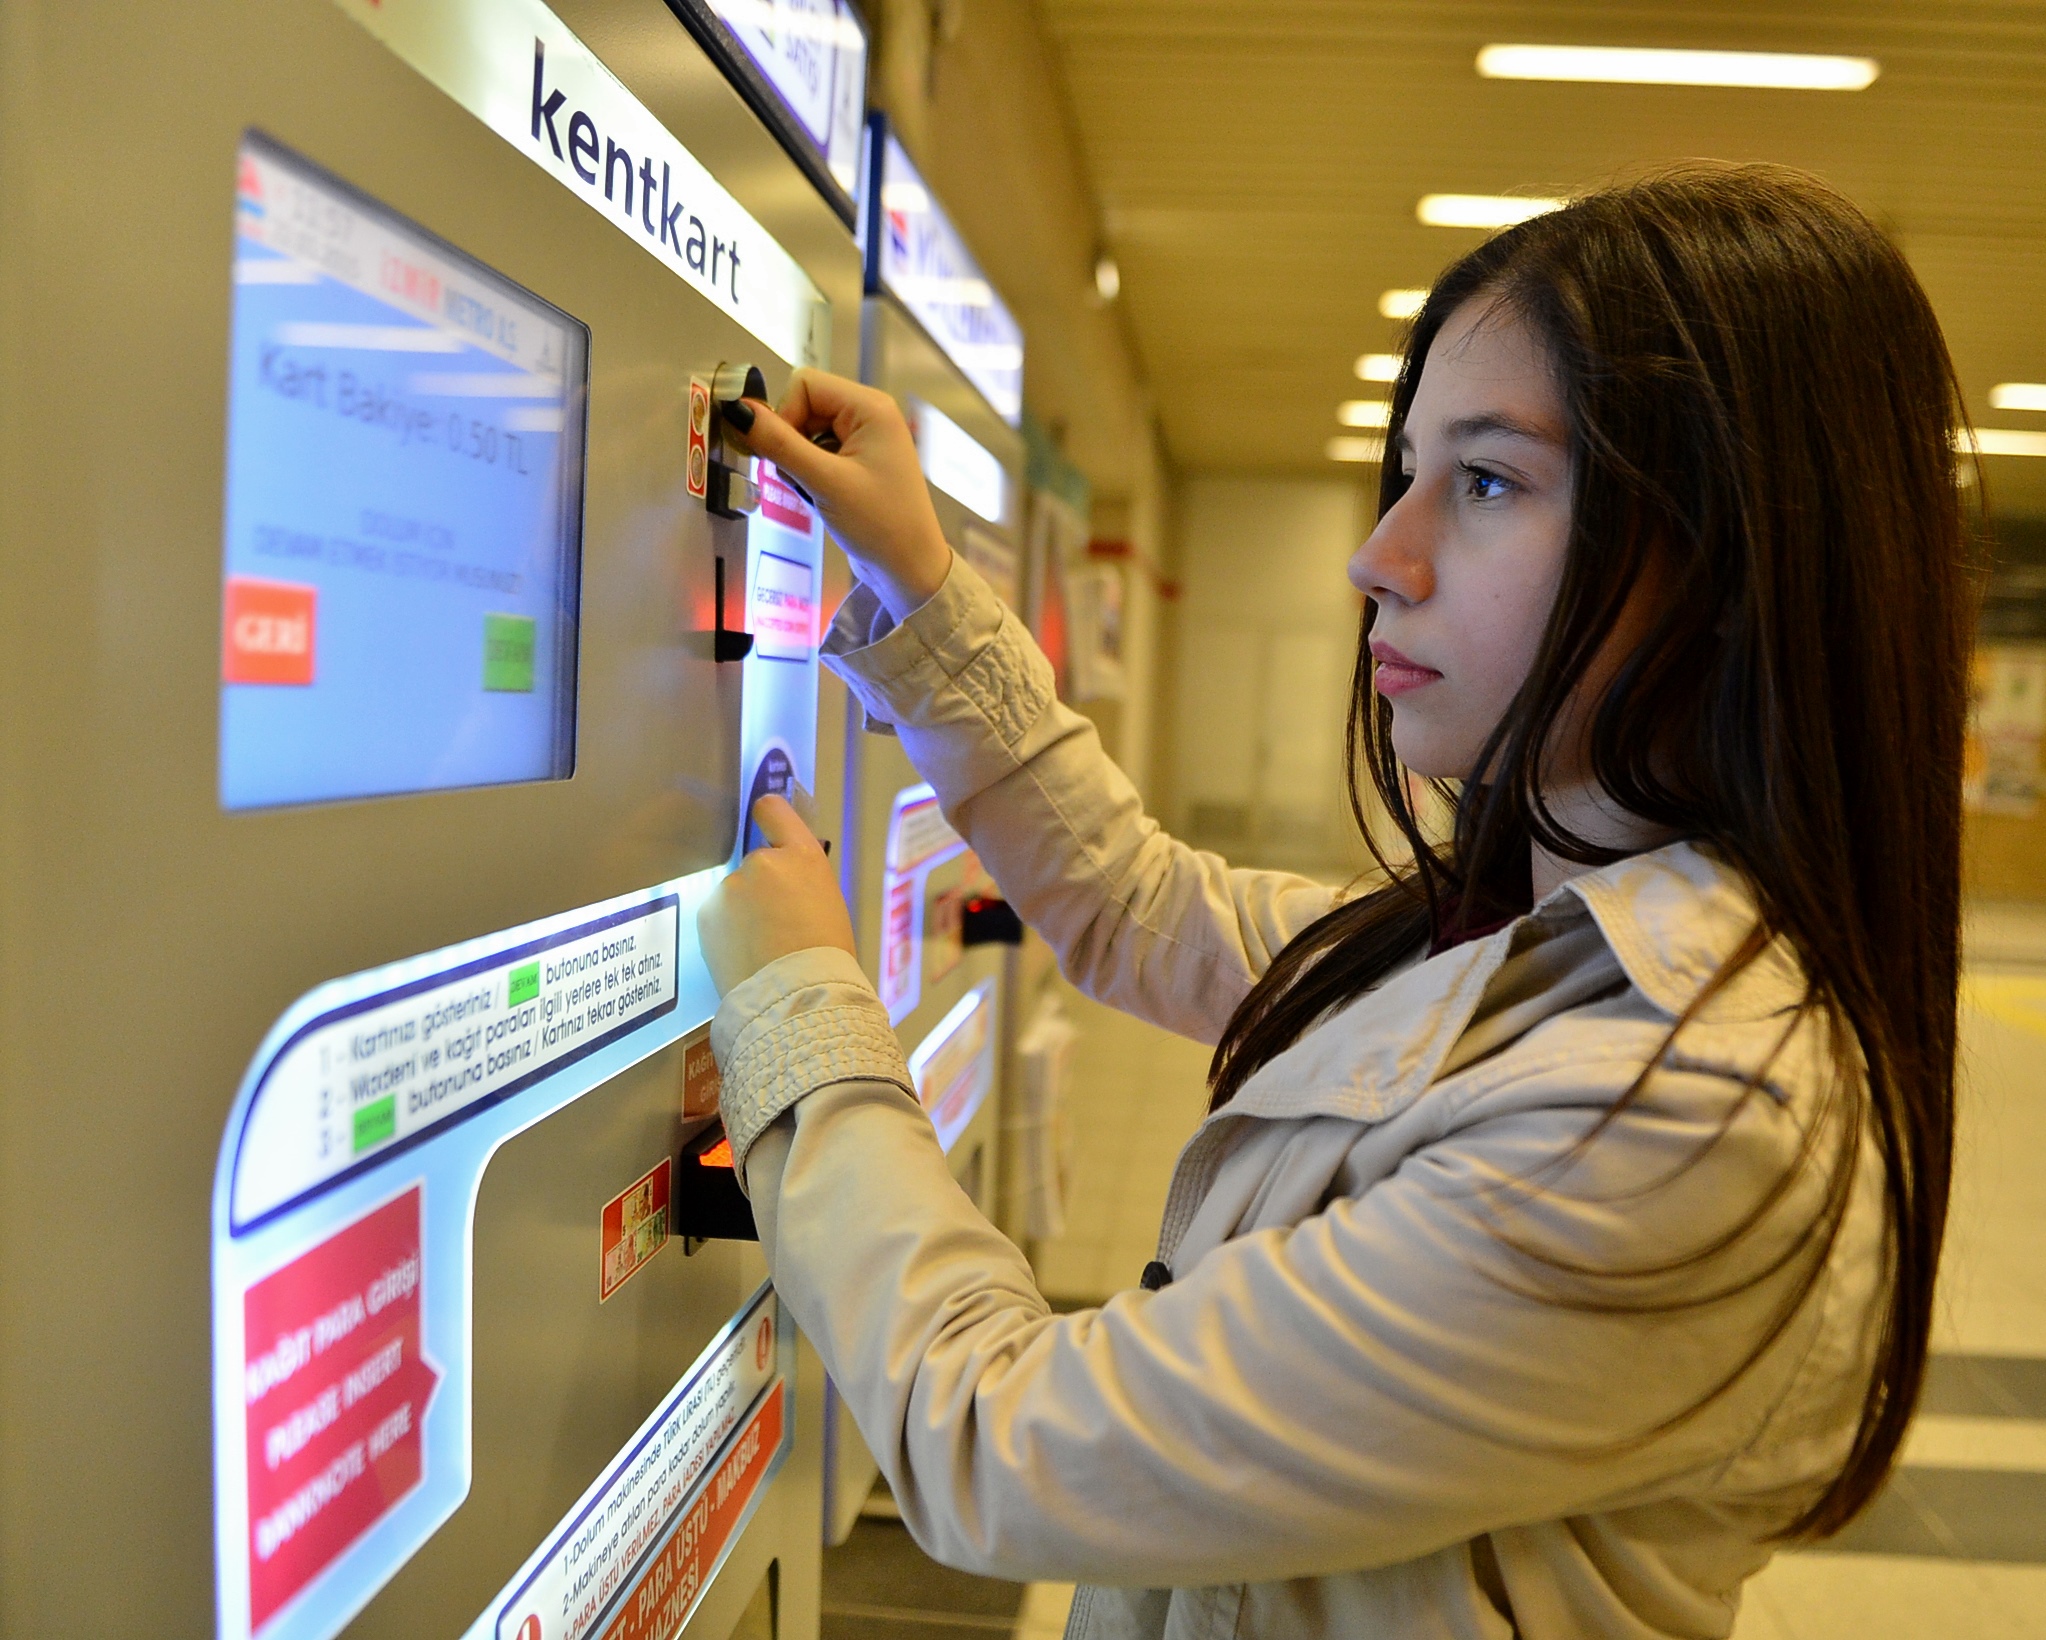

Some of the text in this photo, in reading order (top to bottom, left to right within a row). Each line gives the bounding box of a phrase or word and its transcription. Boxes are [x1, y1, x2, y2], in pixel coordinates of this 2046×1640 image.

[530, 36, 741, 305] kentkart
[260, 341, 327, 409] Kart
[448, 412, 498, 465] 0.50
[503, 432, 529, 475] TL
[407, 1061, 483, 1117] butonuna
[486, 1039, 532, 1076] basınız
[541, 1014, 585, 1051] Kartınızı
[587, 1000, 617, 1028] tekrar
[618, 977, 663, 1017] gösteriniz.
[421, 988, 492, 1044] gösteriniz
[546, 949, 599, 985] butonuna
[602, 935, 637, 963] basınız.
[422, 1049, 441, 1069] ve
[445, 1026, 482, 1061] kağıt
[540, 990, 563, 1023] ilgili
[565, 977, 602, 1014] yerlere
[604, 969, 620, 991] tek
[621, 961, 636, 984] tek
[637, 952, 664, 976] atınız.
[312, 1292, 368, 1356] PARA
[264, 1337, 404, 1471] PLEASE INSERT
[254, 1402, 413, 1563] BANKNOTE HERE
[563, 1532, 619, 1616] 2-Makineye
[621, 1497, 646, 1539] atılan
[646, 1471, 668, 1511] para
[668, 1435, 690, 1478] kadar
[564, 1514, 605, 1576] 1-Dolum
[607, 1443, 662, 1521] makinesinde
[663, 1417, 681, 1450] TÜRK
[599, 1555, 620, 1605] ÜSTÜ
[663, 1480, 682, 1518] PARA
[638, 1550, 674, 1630] PARA
[676, 1490, 710, 1571] ÜSTÜ
[716, 1421, 762, 1512] MAKBUZ
